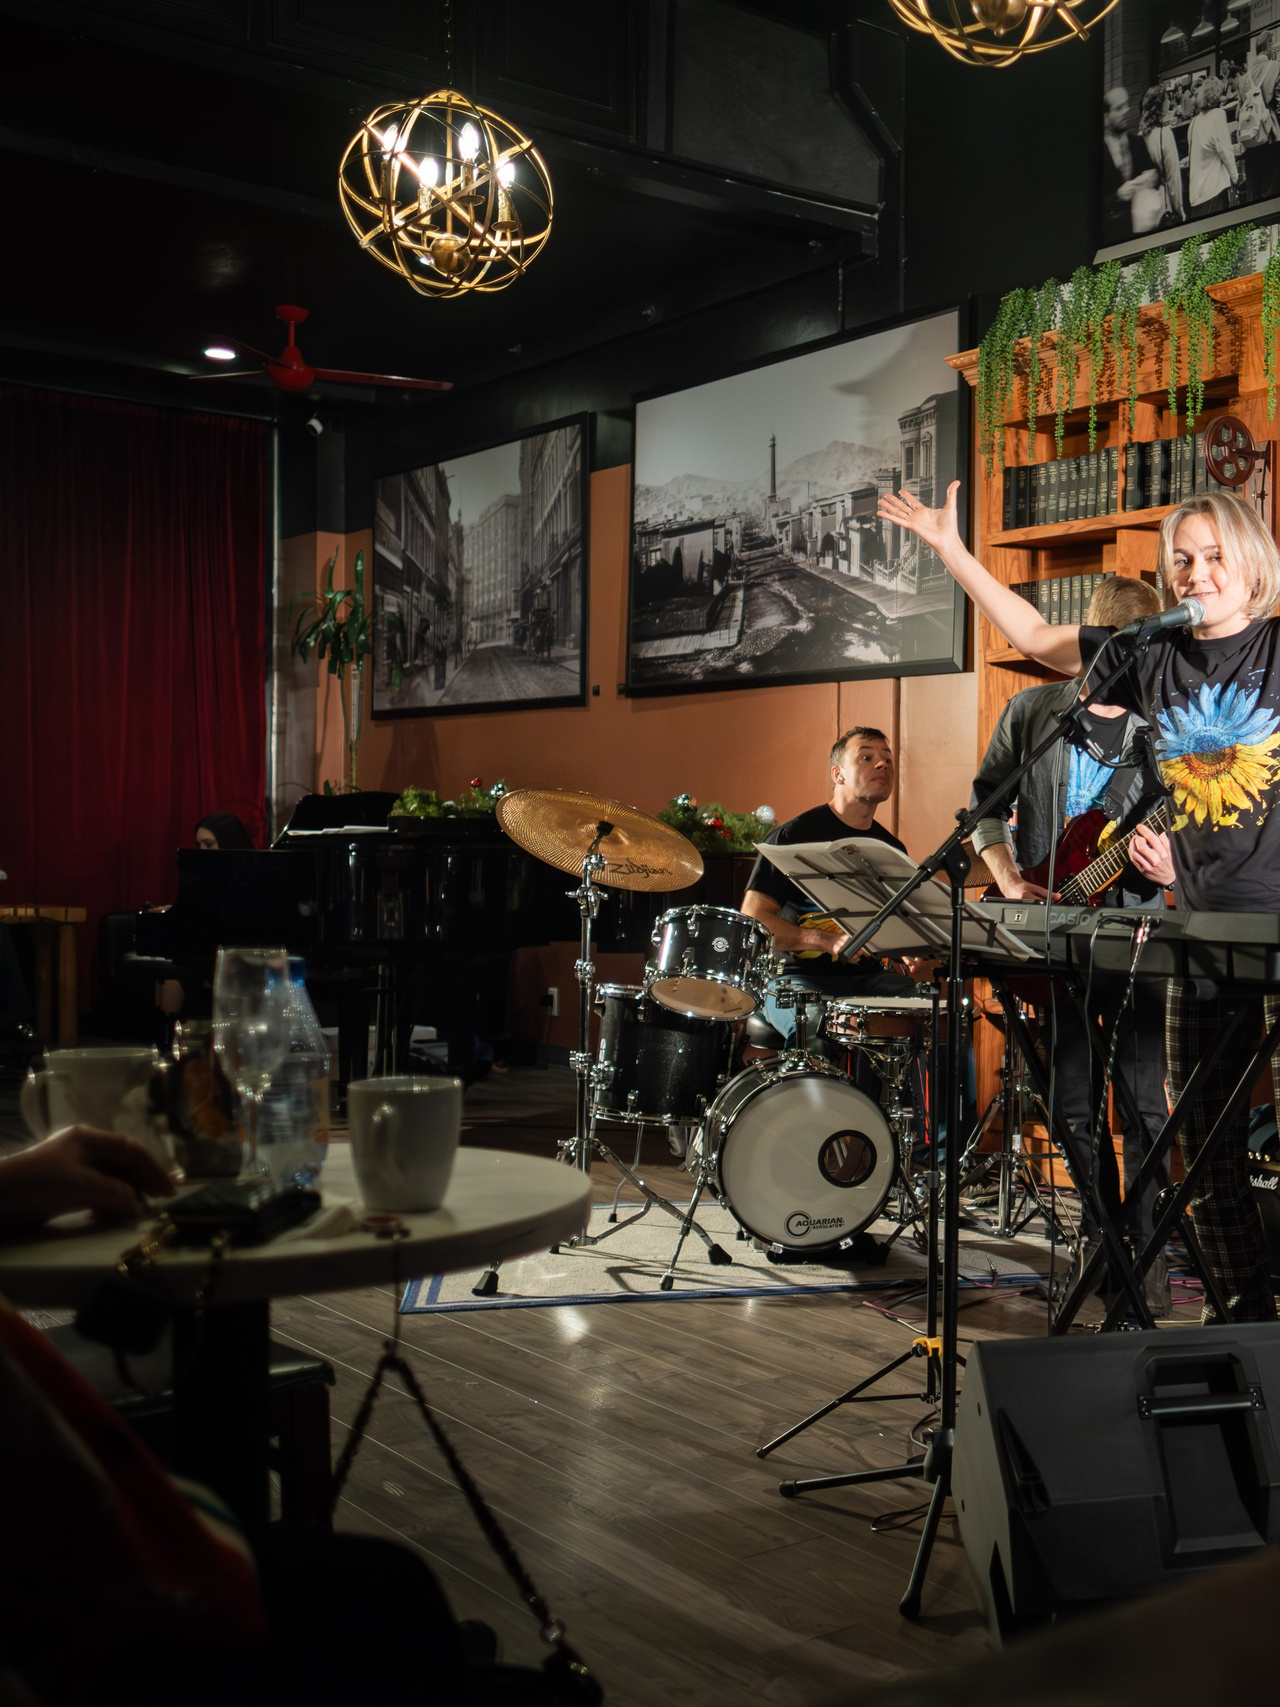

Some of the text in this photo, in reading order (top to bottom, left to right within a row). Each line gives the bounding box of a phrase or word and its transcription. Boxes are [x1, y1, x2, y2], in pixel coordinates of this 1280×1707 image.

[608, 858, 673, 879] Zildjian
[1050, 912, 1091, 926] CASIO
[1249, 1174, 1279, 1191] shall
[795, 1217, 844, 1228] AQUARIAN
